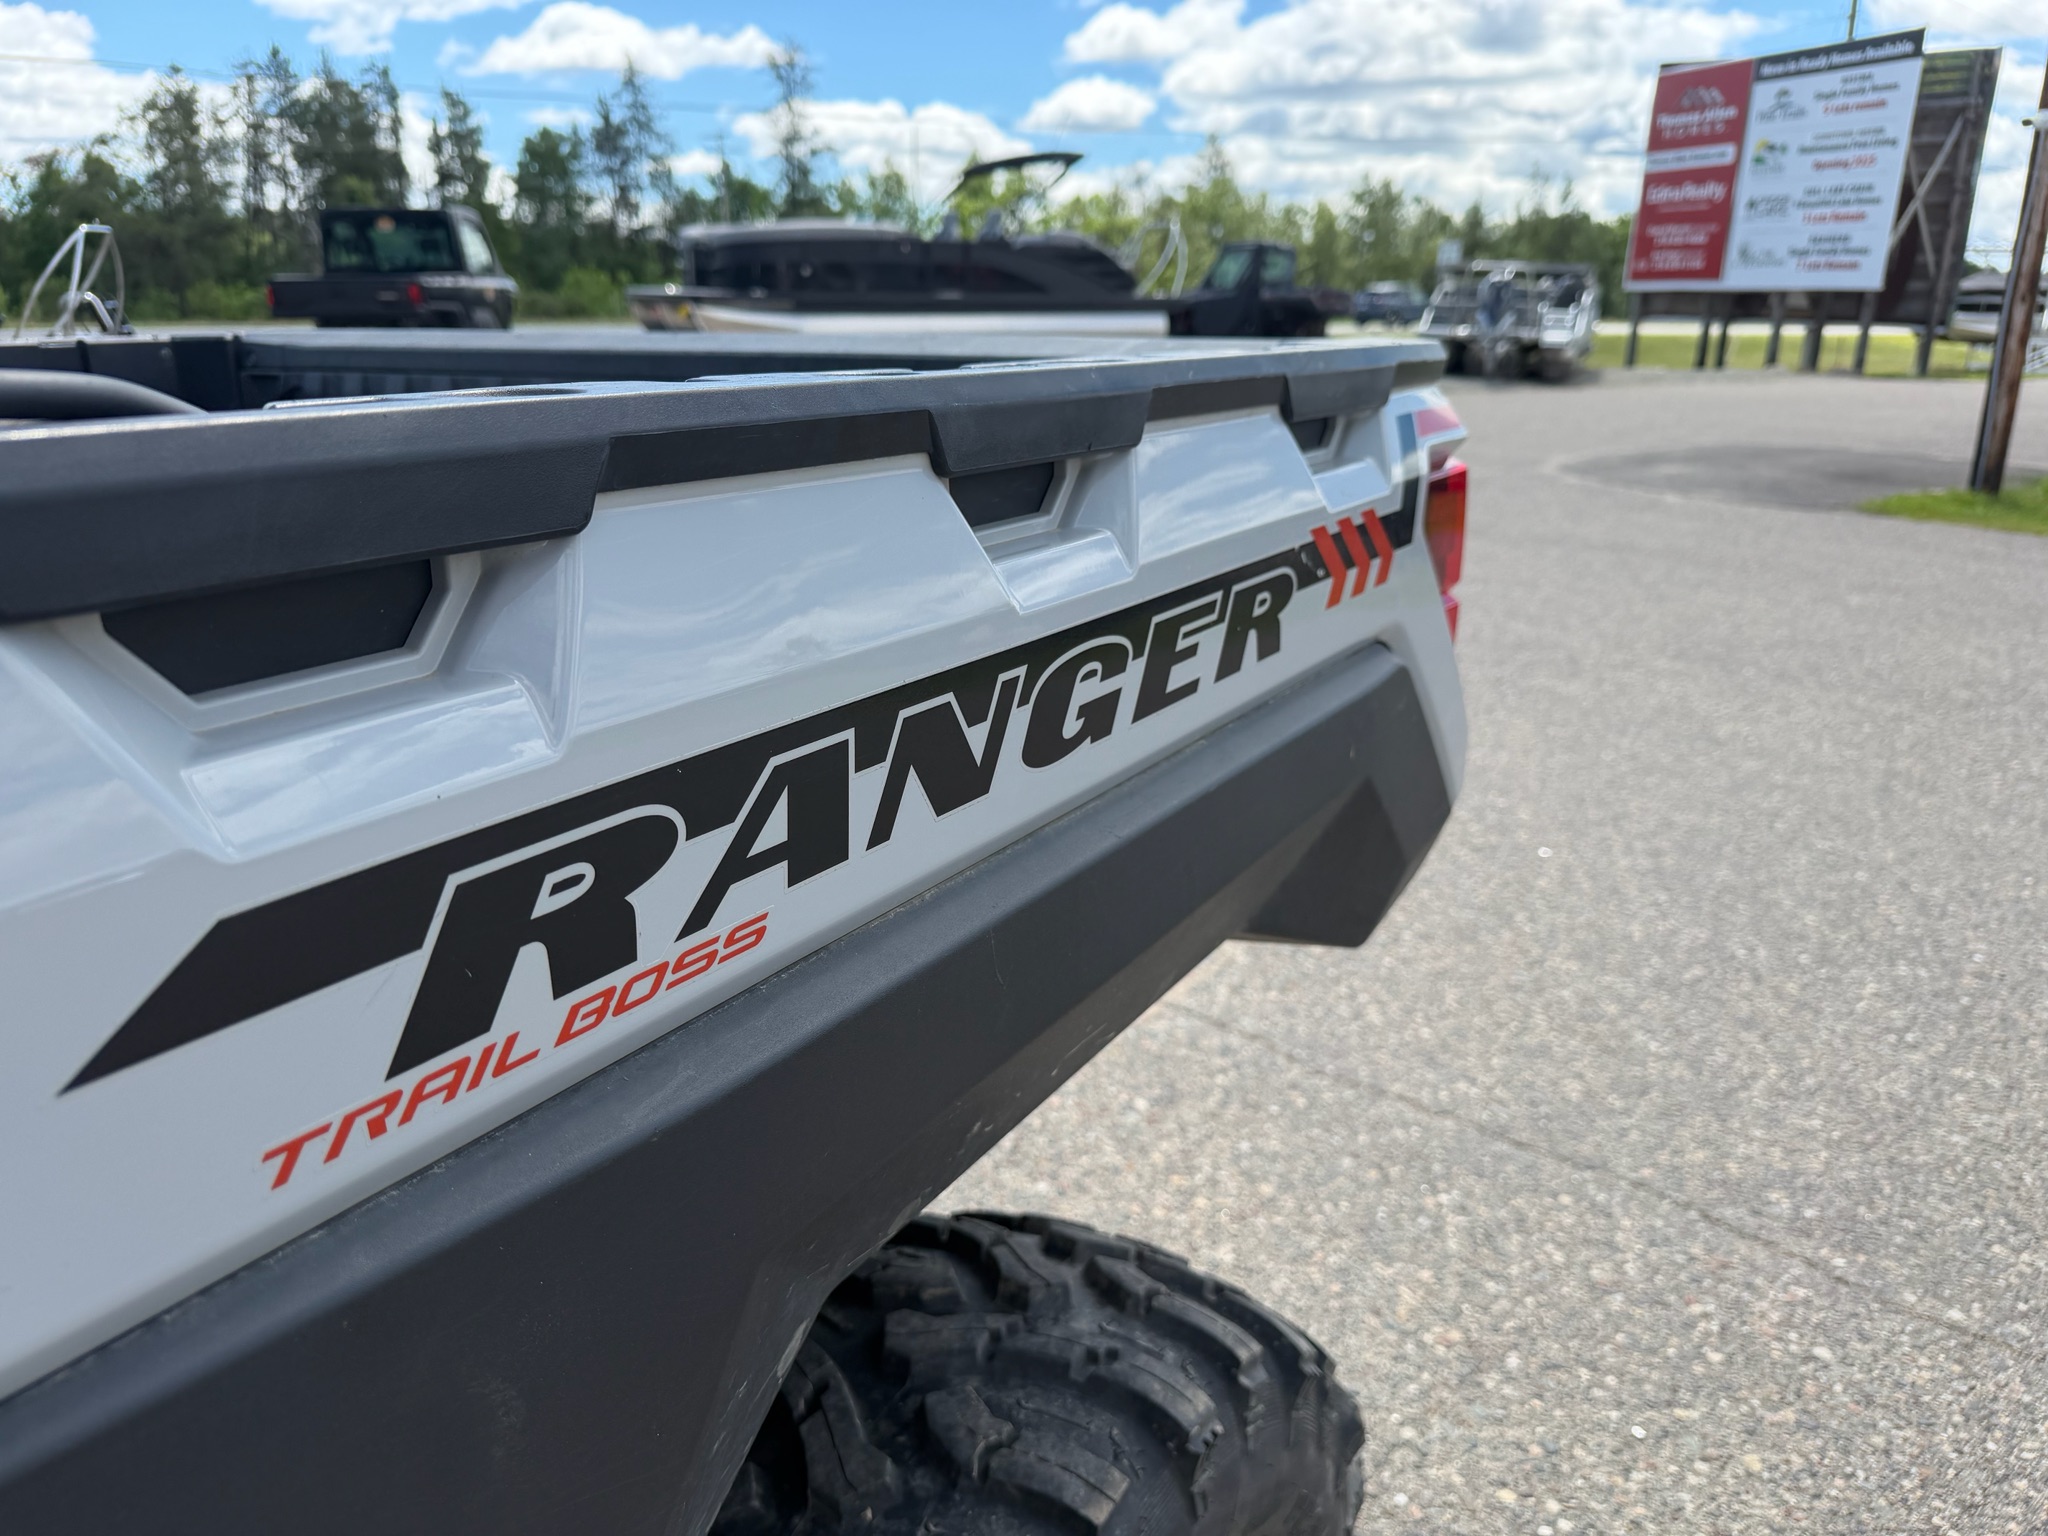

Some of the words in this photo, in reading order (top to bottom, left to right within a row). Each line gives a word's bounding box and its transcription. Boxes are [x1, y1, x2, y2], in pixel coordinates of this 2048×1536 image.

[387, 570, 1294, 1082] RANGER
[262, 1031, 541, 1190] TRAIL
[554, 912, 769, 1047] BOSS
